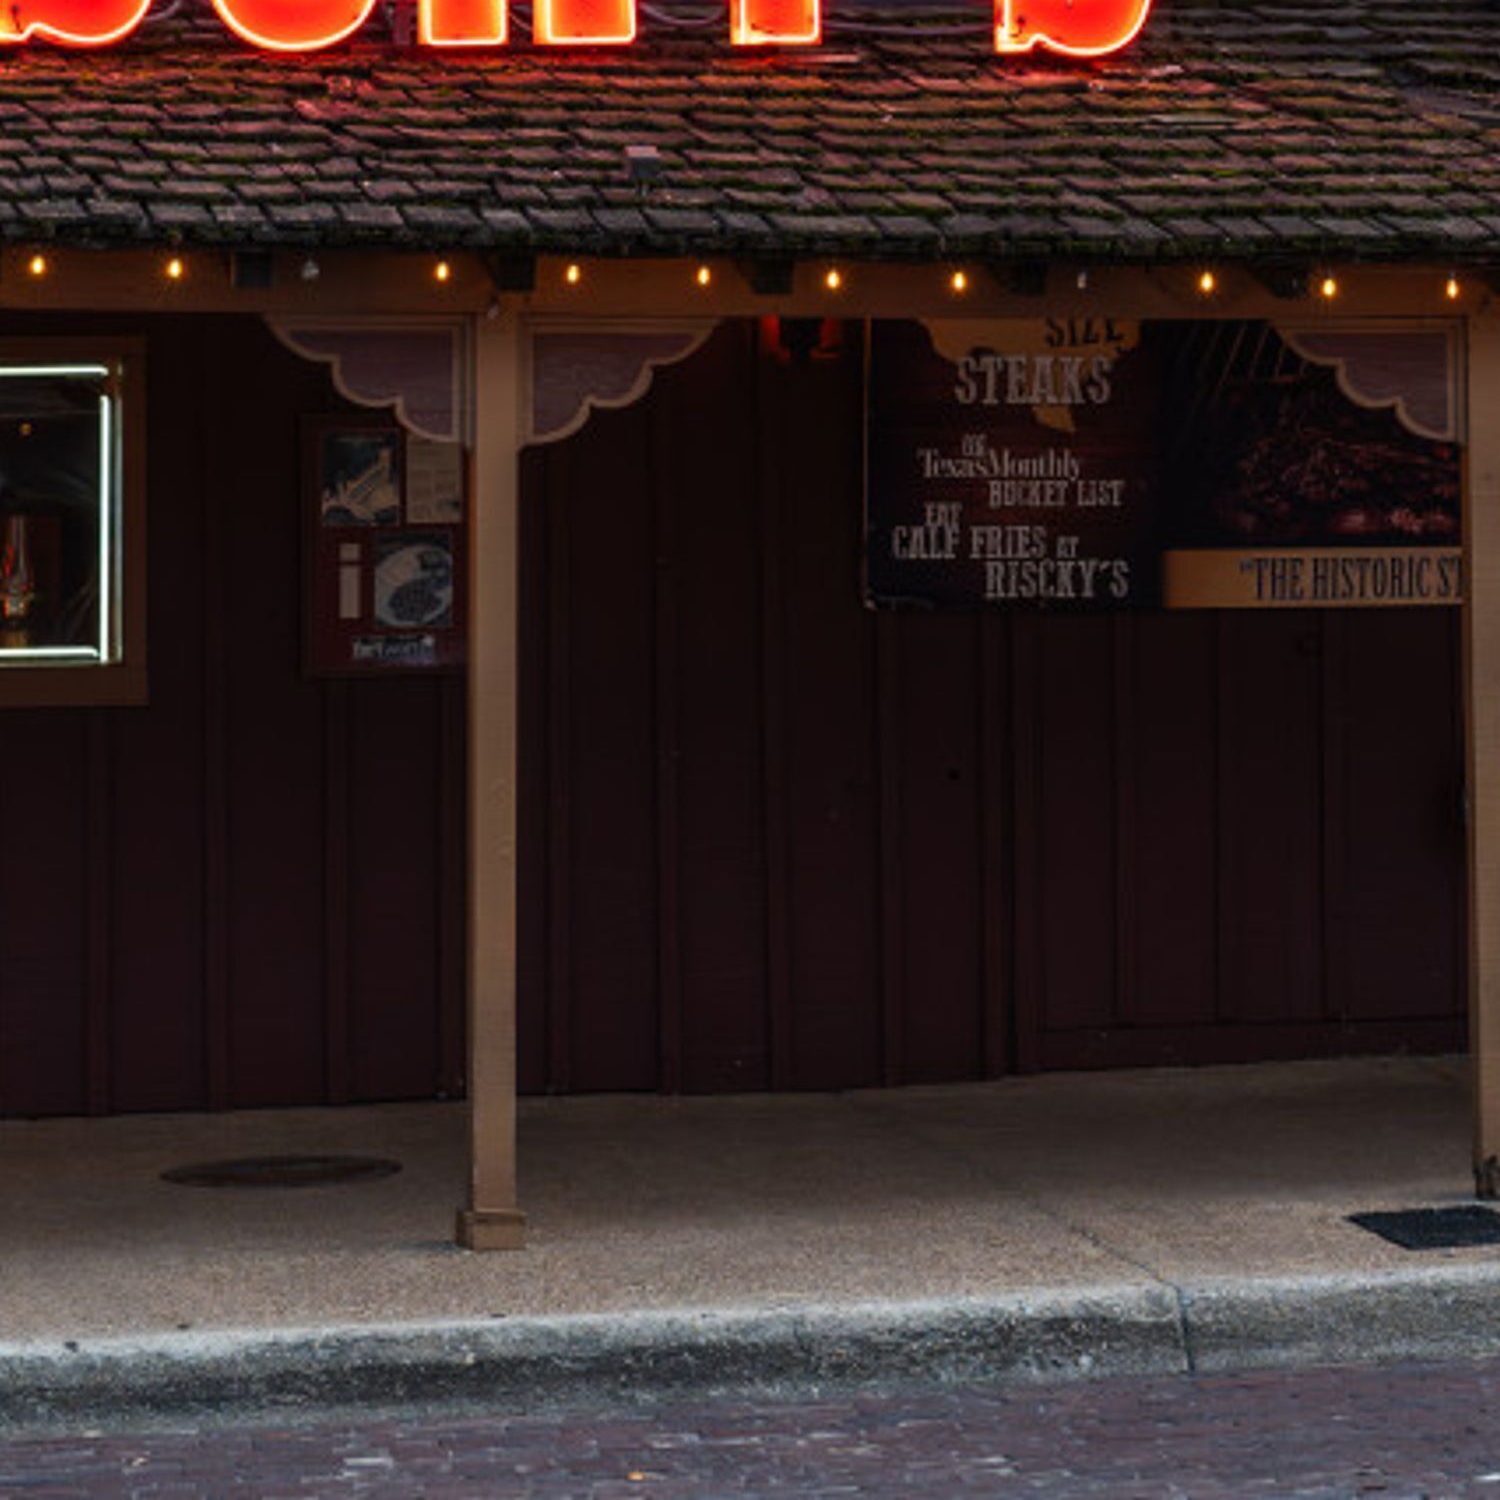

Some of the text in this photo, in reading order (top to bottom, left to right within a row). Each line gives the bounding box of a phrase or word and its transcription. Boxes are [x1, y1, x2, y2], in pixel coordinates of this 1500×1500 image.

[954, 355, 1113, 405] STEAKS
[915, 446, 1081, 482] Texas Monthly
[989, 479, 1125, 509] BUCKET LIST
[892, 524, 962, 560] CALF
[969, 524, 1048, 560] FRIES
[985, 559, 1130, 599] RISCKY'S
[1312, 556, 1430, 600] HISTORIC
